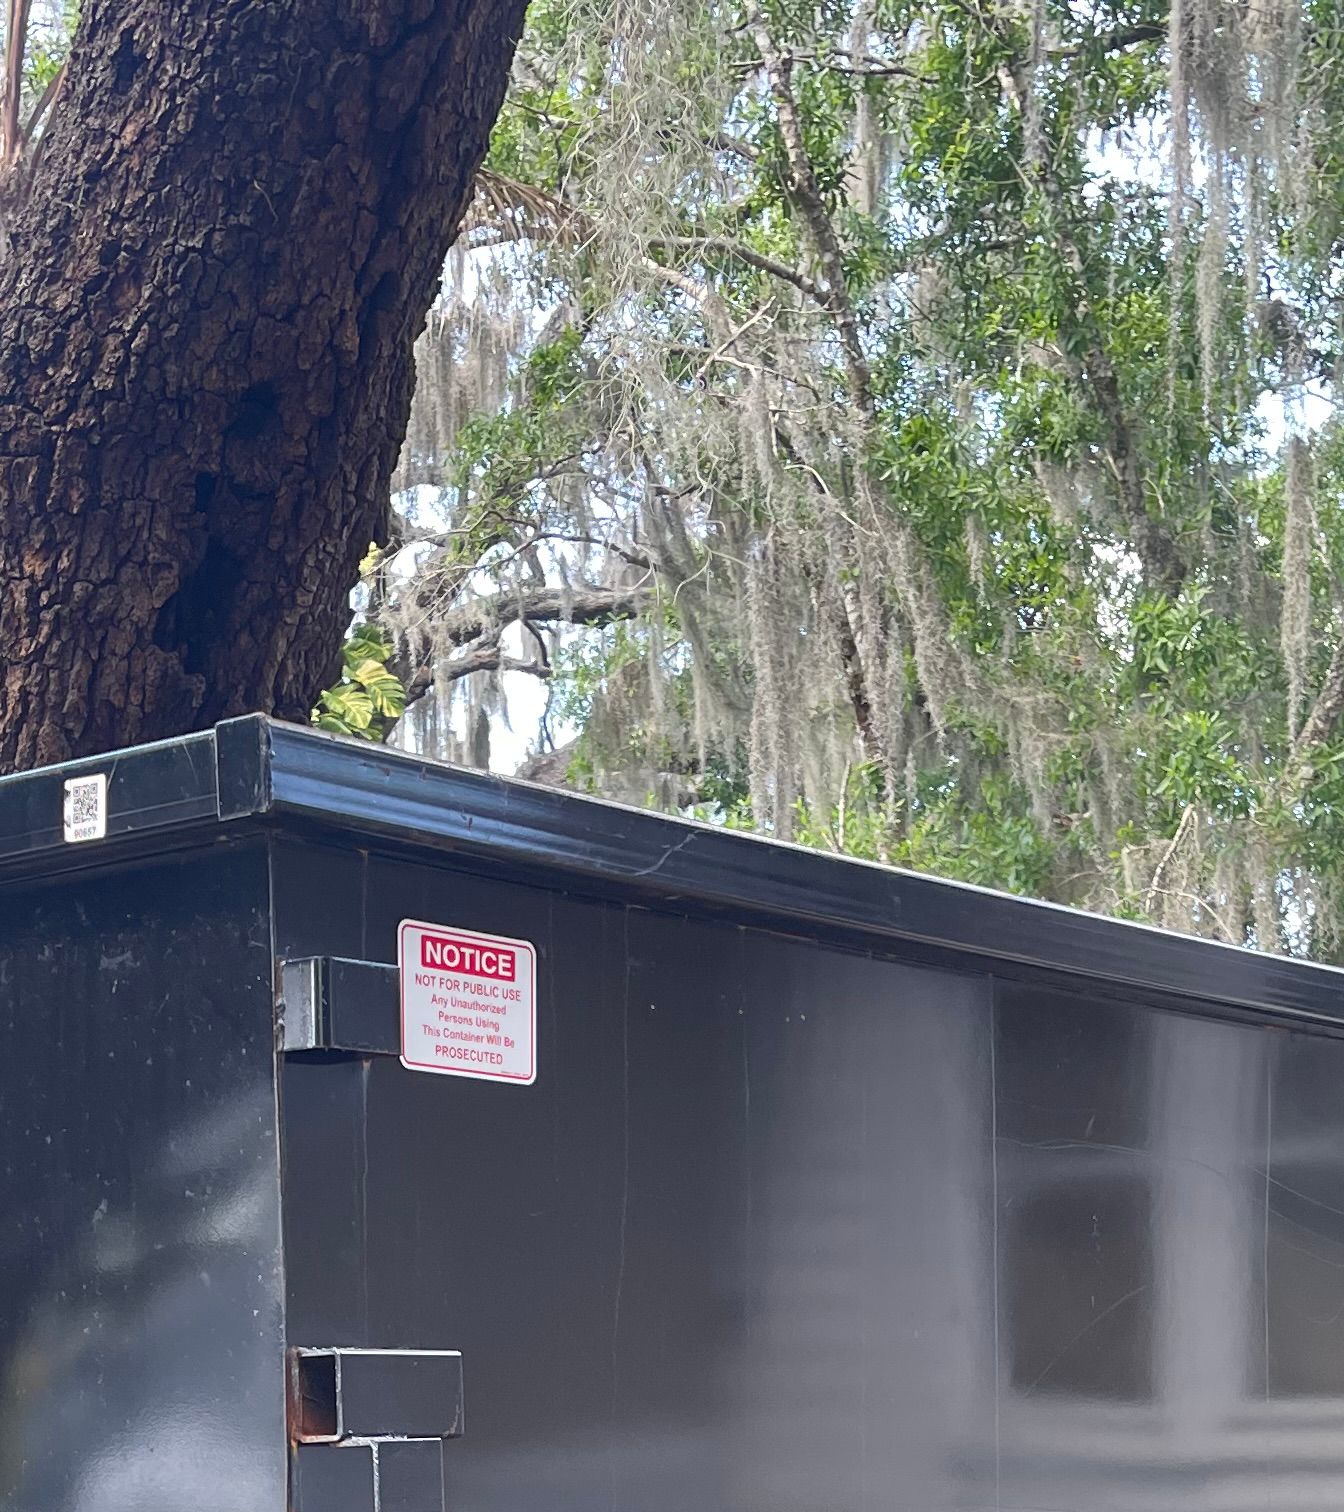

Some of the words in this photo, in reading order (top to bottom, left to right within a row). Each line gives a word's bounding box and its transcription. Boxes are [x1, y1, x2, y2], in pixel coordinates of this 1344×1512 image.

[426, 941, 512, 976] NOTICE
[416, 974, 435, 986] NOT
[440, 978, 459, 991] FOR
[464, 982, 498, 997] PUBLIC
[502, 989, 521, 1001] USE
[432, 994, 447, 1008] Any
[451, 997, 506, 1015] Unauthorized
[439, 1011, 472, 1026] Persons
[476, 1017, 499, 1032] Using
[422, 1025, 440, 1036] This
[443, 1028, 483, 1042] Container
[487, 1034, 500, 1045] Will
[504, 1037, 514, 1048] Be
[436, 1045, 502, 1065] PROSECUTED
